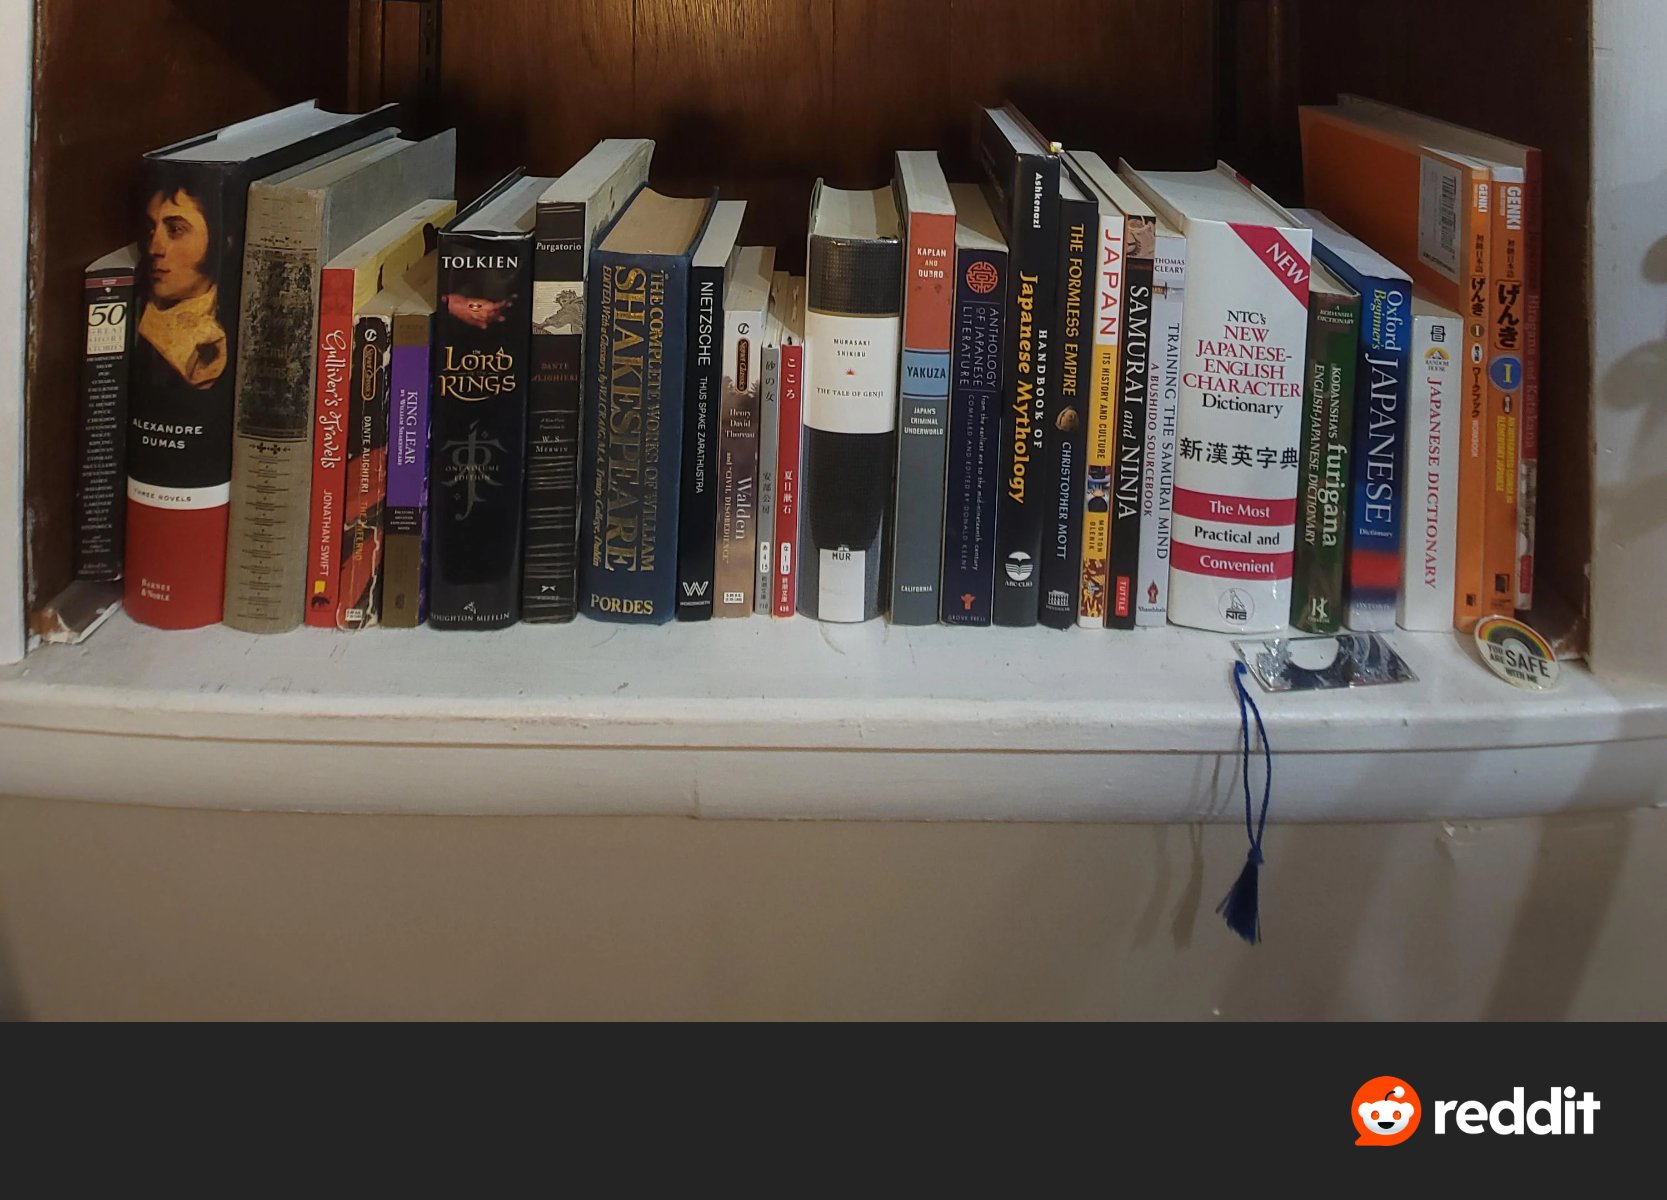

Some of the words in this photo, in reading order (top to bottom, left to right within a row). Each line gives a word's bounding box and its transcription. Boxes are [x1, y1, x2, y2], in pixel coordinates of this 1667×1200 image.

[1033, 171, 1044, 229] Ashkenazi
[1478, 183, 1489, 213] GENKI
[1506, 185, 1522, 231] GENKI
[535, 241, 582, 252] Purgatorio
[1069, 223, 1084, 253] THE
[441, 256, 519, 269] TOLKIEN
[917, 247, 947, 258] KAPLAN
[1155, 257, 1185, 266] THOMAS
[1265, 242, 1310, 286] NEW
[1099, 228, 1121, 336] JAPAN
[1154, 265, 1184, 274] CLEARY
[1066, 258, 1083, 338] FORMLESS
[87, 303, 127, 326] 50
[698, 281, 715, 367] NIETZSCHE
[1015, 271, 1039, 374] Japanese
[1226, 309, 1267, 325] NTC's
[1385, 290, 1404, 354] Oxford
[1496, 283, 1520, 349] げんき
[833, 338, 871, 347] MURASAKI
[1122, 284, 1149, 404] SAMURAI
[1223, 325, 1270, 343] NEW
[444, 346, 514, 372] LORD
[837, 349, 866, 358] SHIKIBU
[1196, 340, 1293, 362] JAPANESE-
[906, 365, 947, 380] YAKUZA
[1062, 343, 1078, 397] EMPIRE
[1203, 359, 1285, 380] ENGLISH
[438, 374, 517, 401] RINGS
[1182, 371, 1301, 399] CHARACTER
[913, 407, 937, 416] JAPAN'S
[1202, 392, 1284, 419] Dictionary
[131, 417, 203, 435] ALEXANDRE
[904, 427, 944, 436] UNDERWORLD
[910, 417, 938, 426] CRIMINAL
[1122, 416, 1136, 440] and
[1425, 377, 1443, 467] JAPANESE
[142, 435, 186, 450] DUMAS
[1008, 379, 1033, 504] Mythology
[1364, 353, 1399, 523] JAPANESE
[1179, 436, 1299, 470] 新漢英字典
[1118, 445, 1142, 520] NINJA
[1318, 444, 1348, 547] furigana
[735, 477, 753, 540] Walden
[1209, 500, 1234, 515] The
[1237, 503, 1271, 519] Most
[1194, 524, 1252, 545] Practical
[1256, 531, 1281, 546] and
[1424, 471, 1441, 590] DICTIONARY
[831, 552, 852, 562] MUR
[1199, 554, 1275, 575] Convenient
[900, 585, 933, 593] CALIFORNIA
[590, 593, 654, 615] PORDES
[1505, 648, 1551, 679] SAFE
